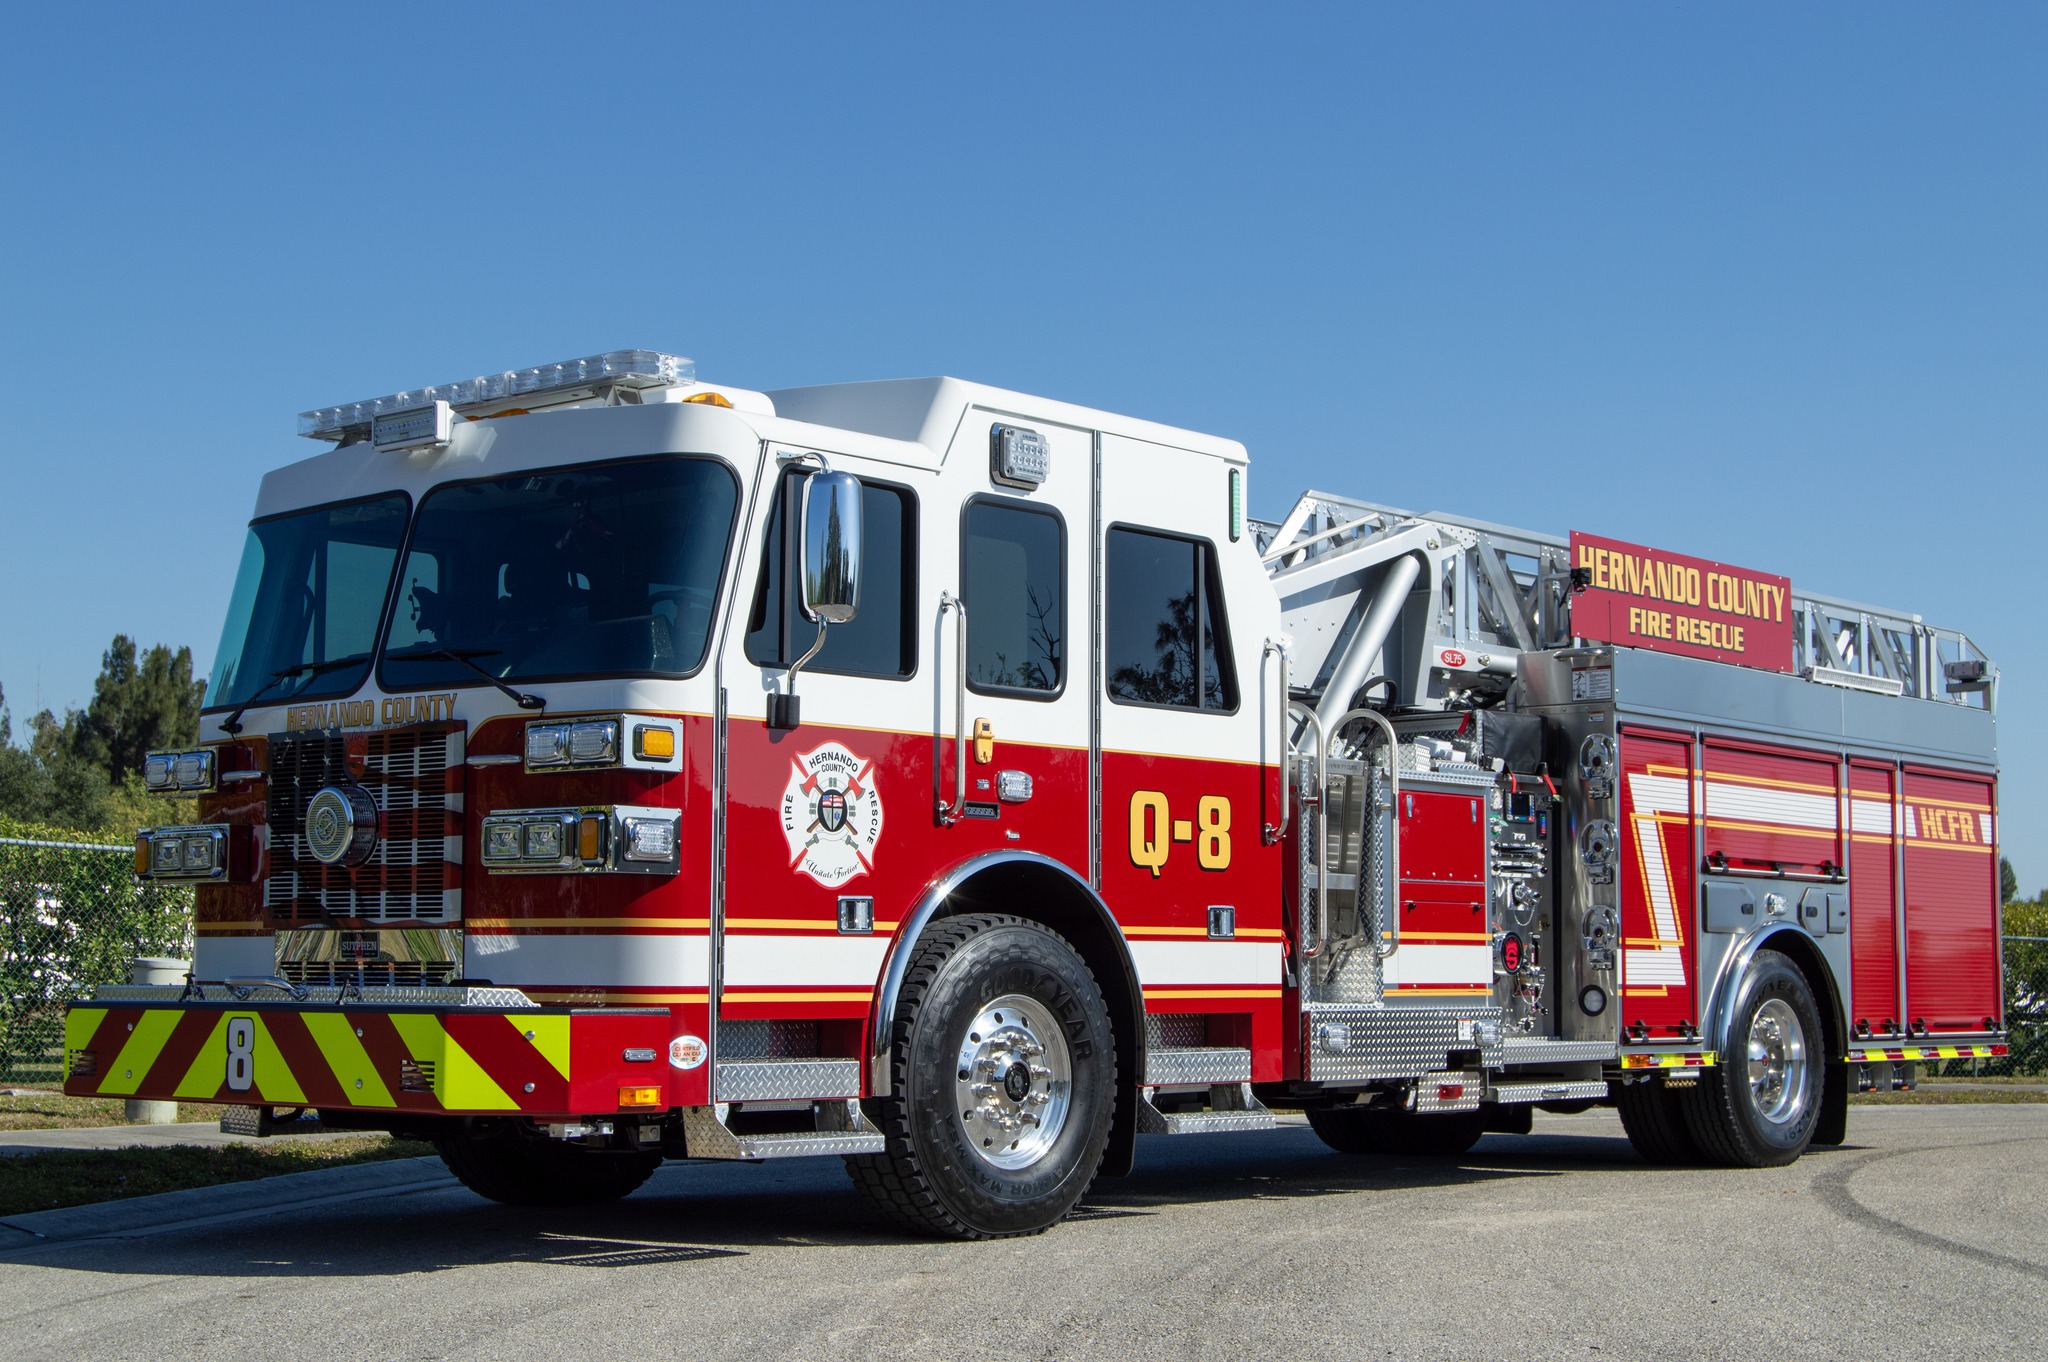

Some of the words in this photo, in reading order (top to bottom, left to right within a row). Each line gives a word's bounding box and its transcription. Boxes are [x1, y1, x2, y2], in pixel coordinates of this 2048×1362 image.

[1578, 544, 1701, 607] HERNANDO
[1707, 571, 1785, 623] COUNTY
[1629, 606, 1672, 640] FIRE
[1675, 615, 1745, 653] RESCUE
[1444, 652, 1463, 665] SL75
[287, 699, 375, 733] HERNANDO
[381, 692, 458, 725] COUNTY
[809, 751, 858, 772] HERNANDO
[821, 763, 846, 774] COUNTY
[784, 794, 794, 831] FIRE
[867, 790, 879, 845] RESCUE
[1919, 807, 1976, 842] HCFR
[1128, 789, 1231, 879] Q-8
[342, 941, 377, 951] SUTPHEN
[226, 1017, 255, 1092] 8
